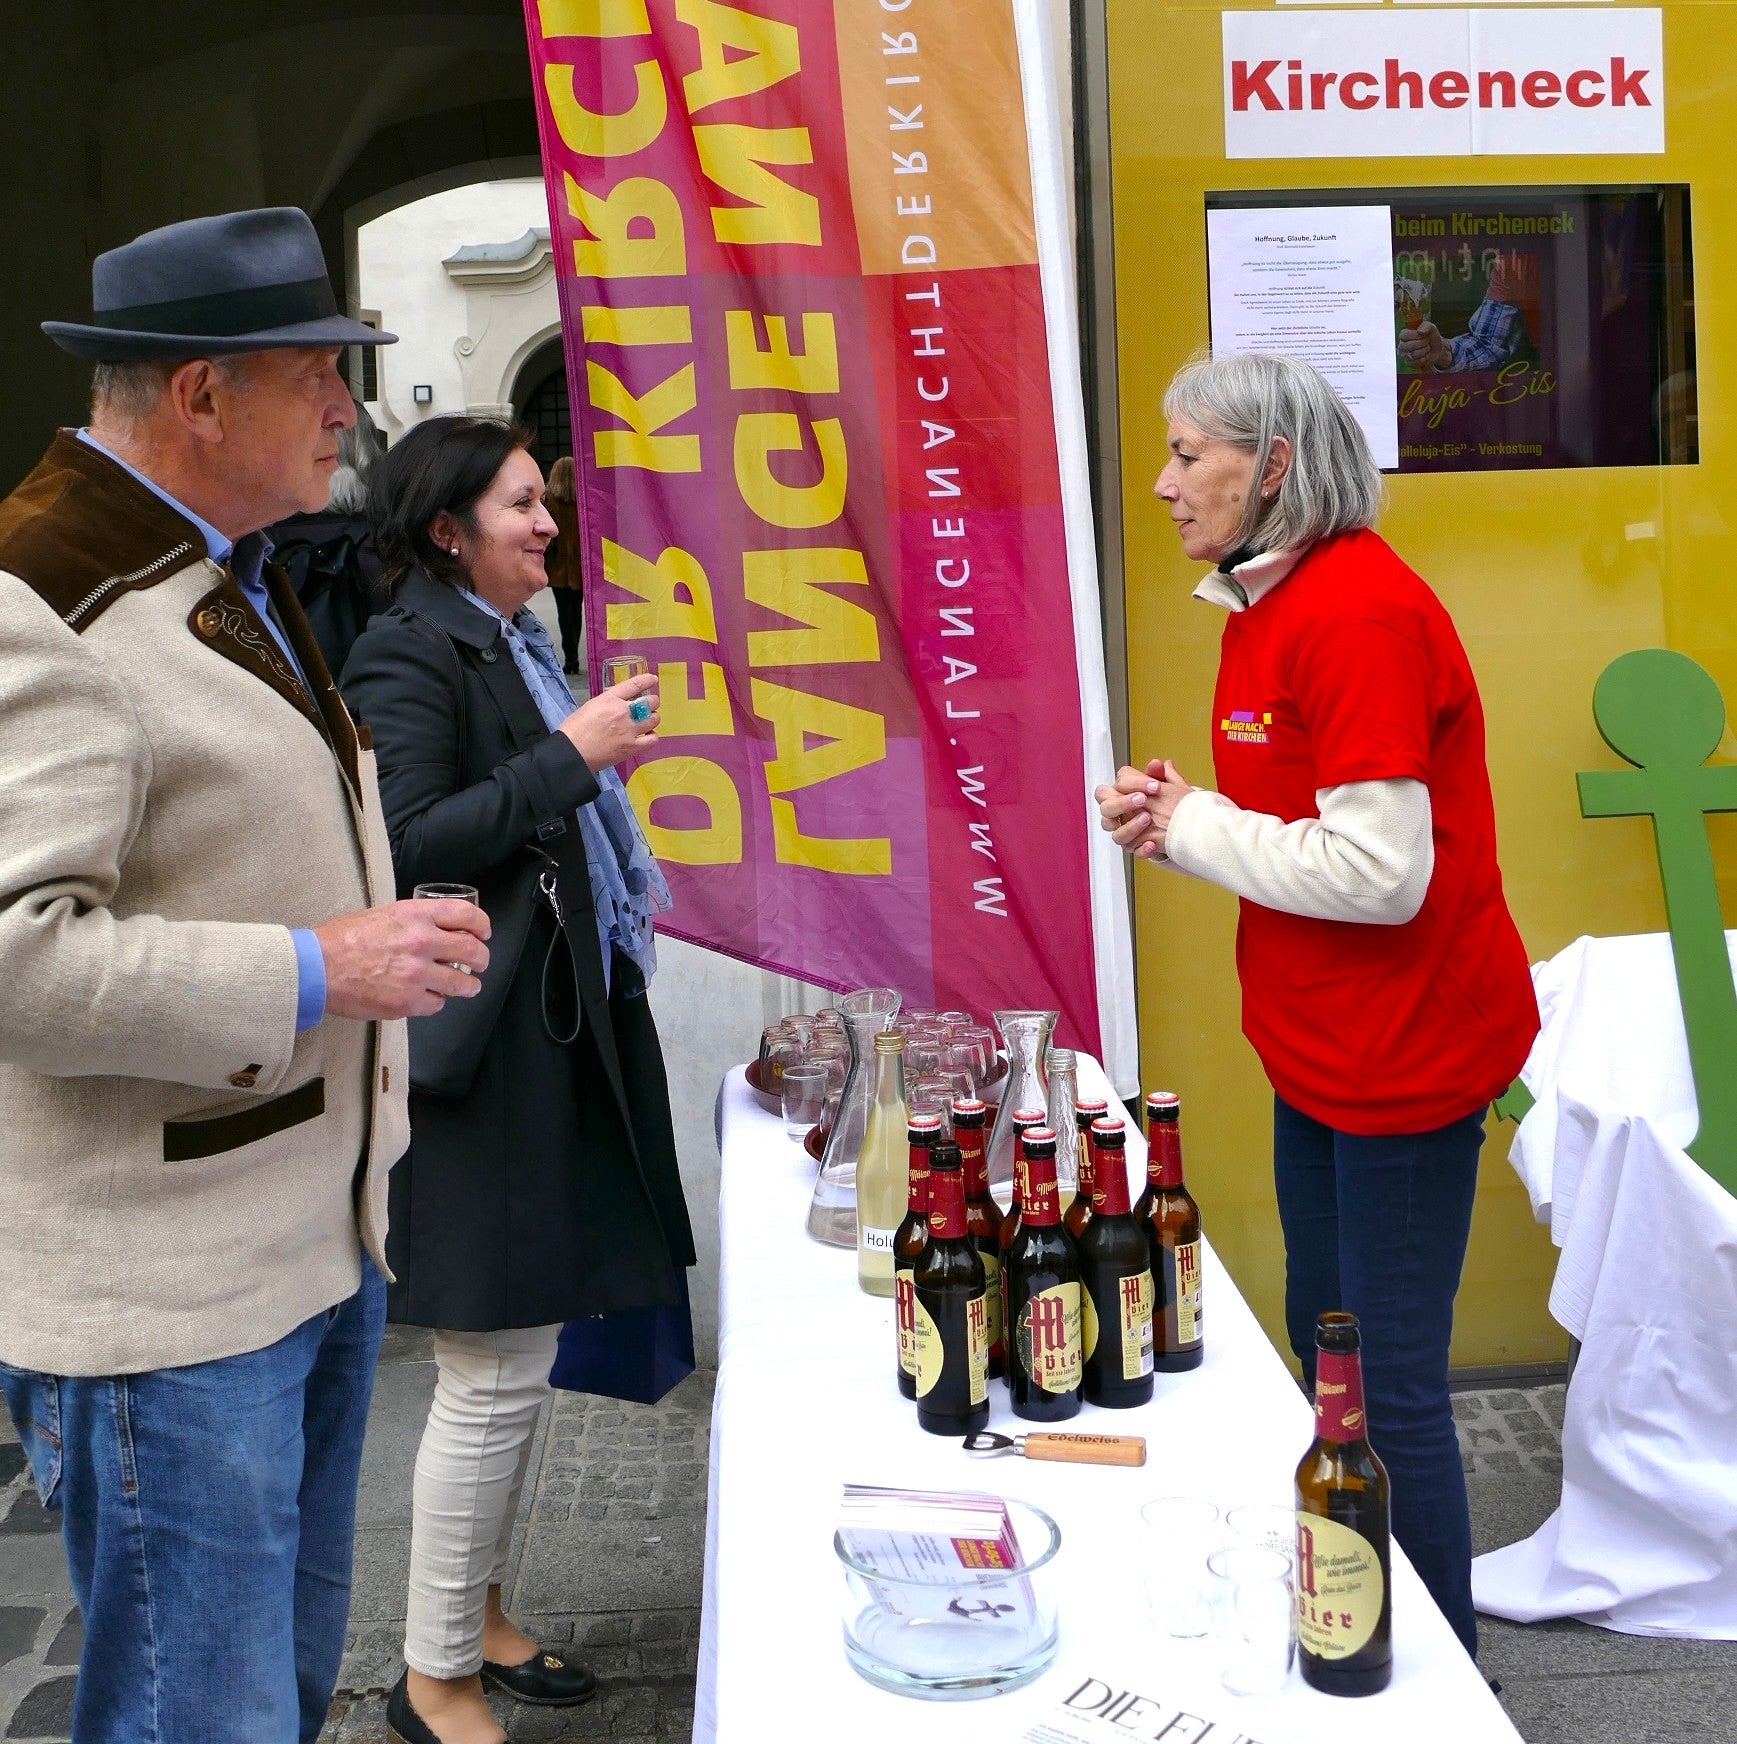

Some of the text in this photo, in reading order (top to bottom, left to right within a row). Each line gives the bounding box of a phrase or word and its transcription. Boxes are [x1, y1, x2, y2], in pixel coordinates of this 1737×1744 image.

[1231, 57, 1652, 111] Kircheneck
[1395, 211, 1575, 237] beim Kircheneck
[1254, 235, 1286, 243] Hoffnung,
[1397, 360, 1556, 429] luja-Eis
[1399, 443, 1543, 460] alleluja-Eis” Verkostung
[1048, 1433, 1120, 1444] Edelweiss
[1062, 1677, 1161, 1730] DIE
